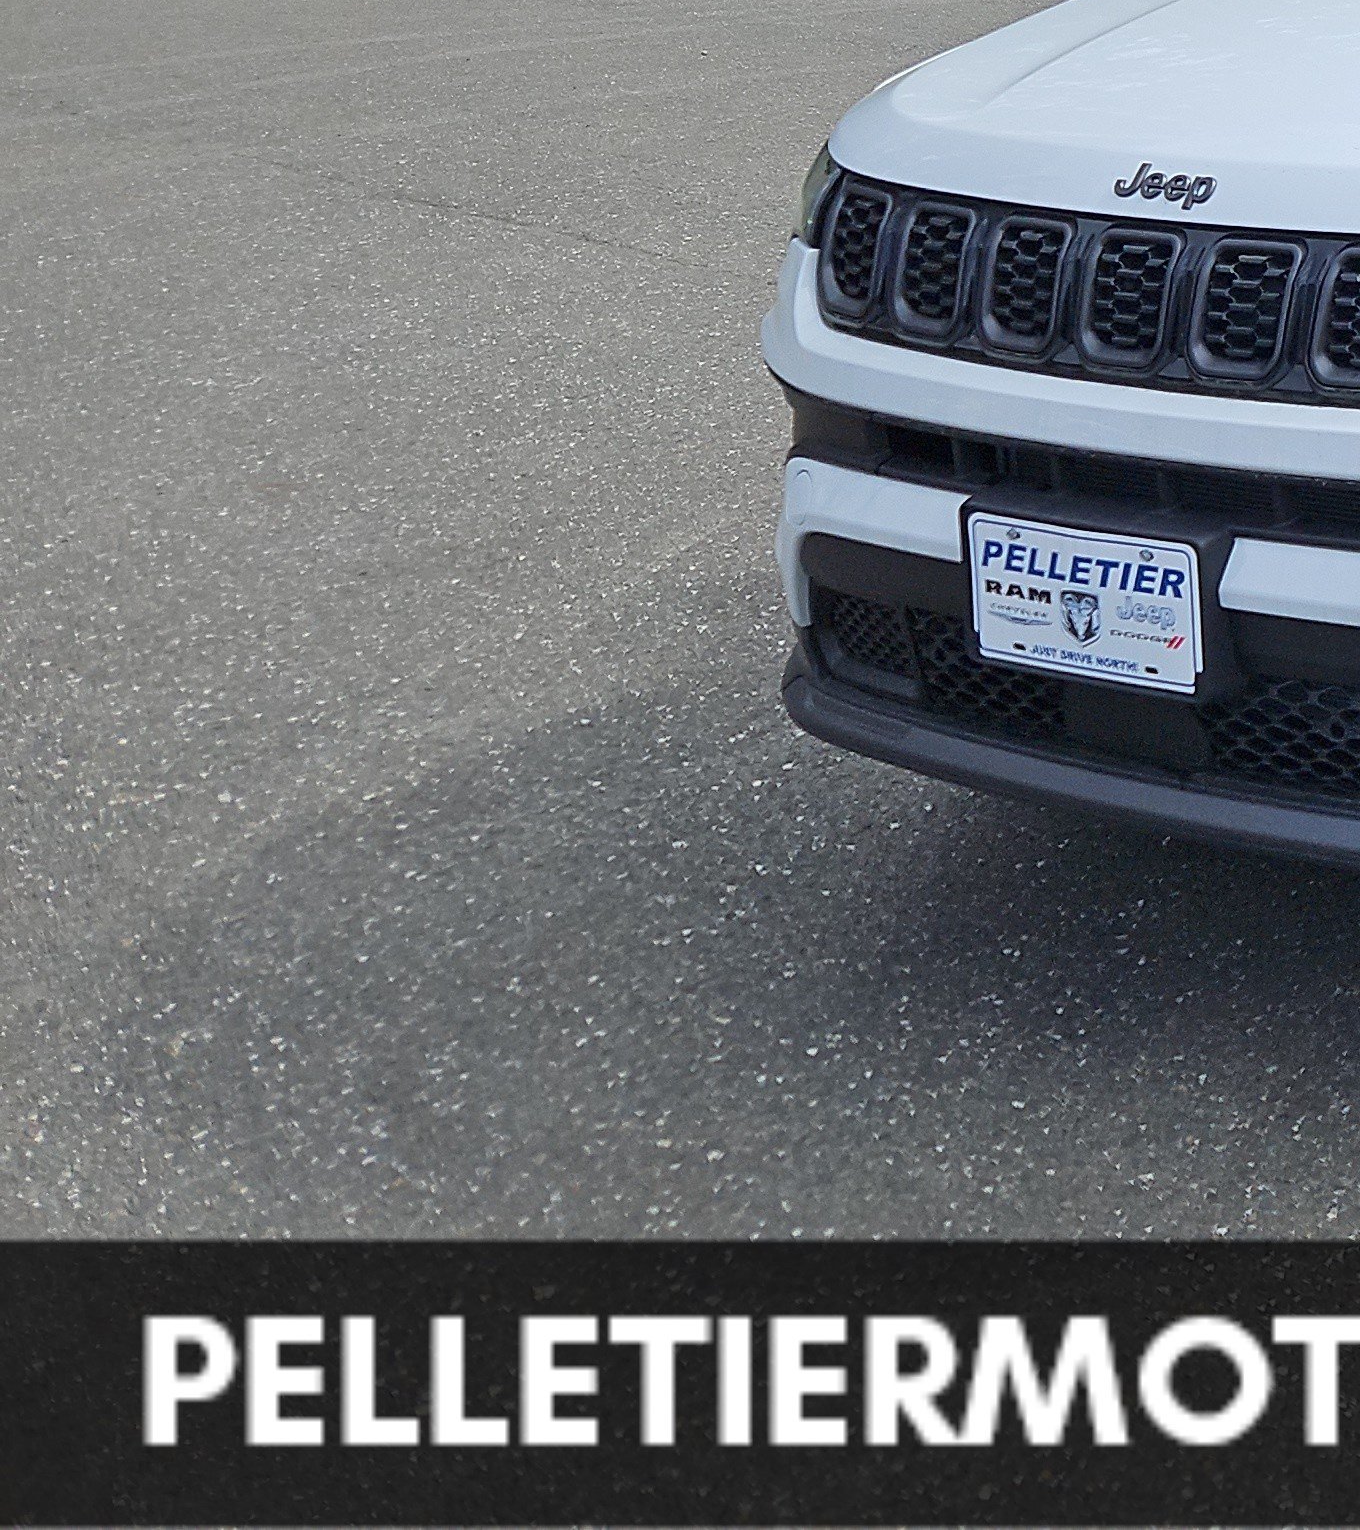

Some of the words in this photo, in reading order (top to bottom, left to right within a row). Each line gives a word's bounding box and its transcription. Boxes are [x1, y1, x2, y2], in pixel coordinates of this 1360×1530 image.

[1114, 162, 1217, 210] Jeep
[981, 539, 1186, 599] PELLETIER
[985, 578, 1052, 605] RAM
[1115, 596, 1176, 631] Jeep
